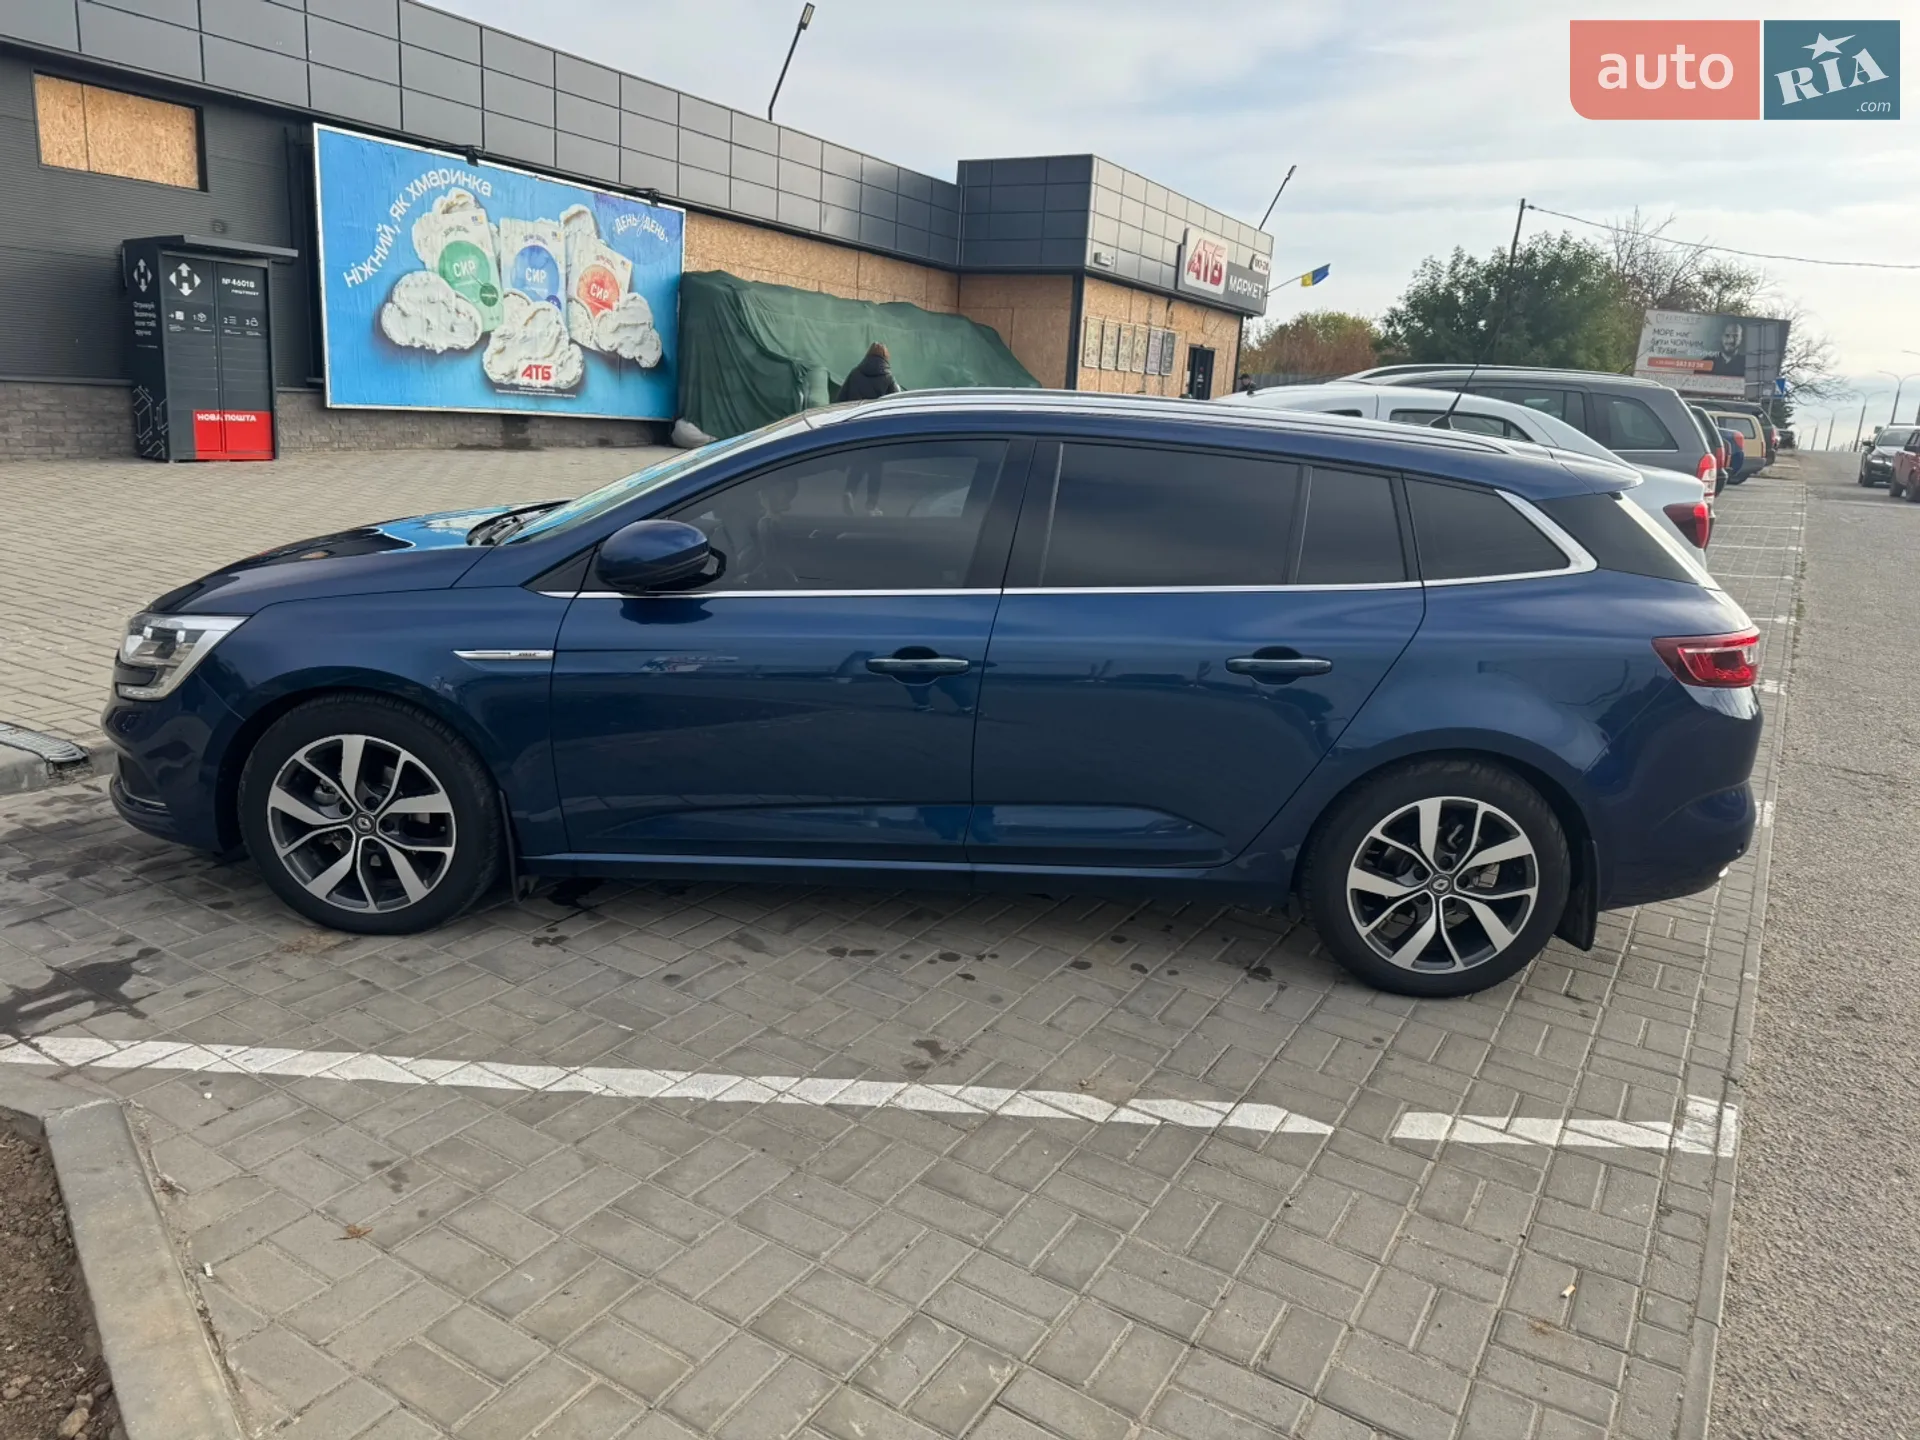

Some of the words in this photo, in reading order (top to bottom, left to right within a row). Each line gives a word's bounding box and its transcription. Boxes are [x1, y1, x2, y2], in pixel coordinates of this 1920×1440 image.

[405, 167, 493, 201] хмаринка
[453, 260, 476, 277] СИР
[1187, 238, 1226, 287] АТБ
[525, 268, 547, 284] СИР
[590, 283, 609, 301] СИР
[1228, 275, 1264, 300] МАРКЕТ
[521, 364, 553, 381] АТБ
[196, 413, 223, 422] НОВА
[224, 414, 257, 422] ПОШТА
